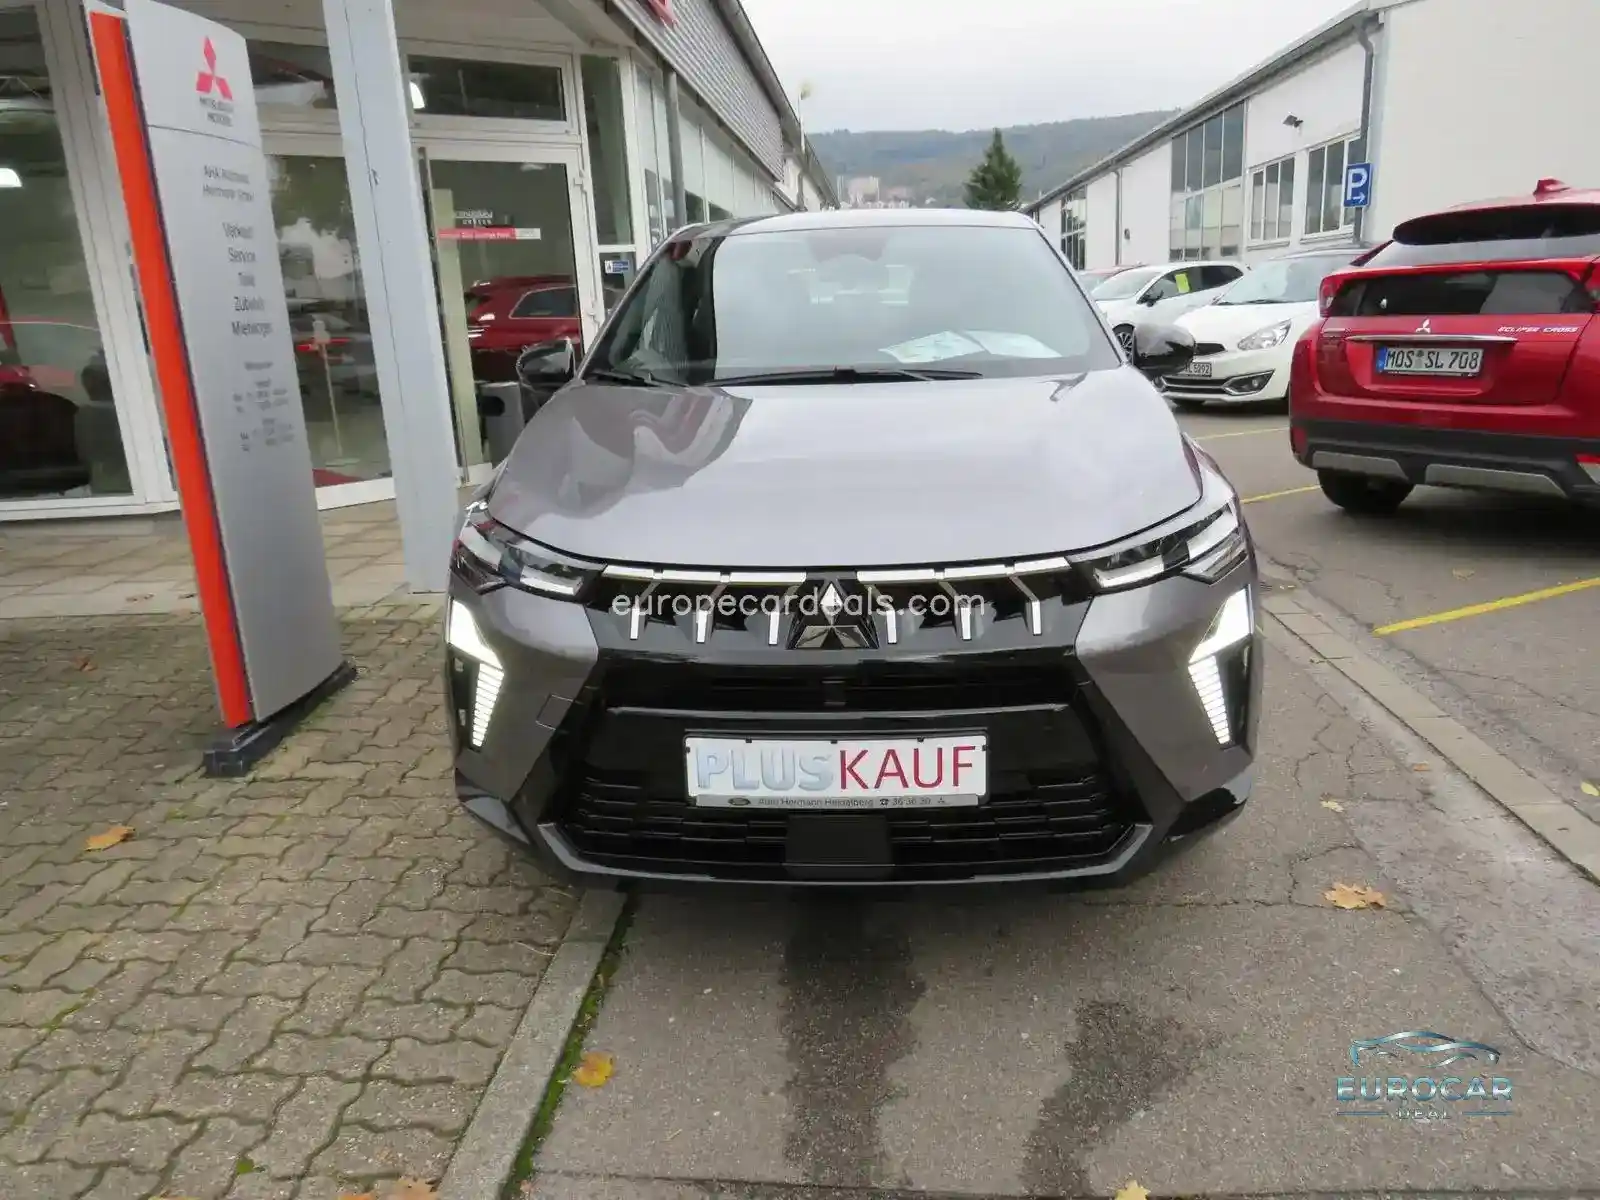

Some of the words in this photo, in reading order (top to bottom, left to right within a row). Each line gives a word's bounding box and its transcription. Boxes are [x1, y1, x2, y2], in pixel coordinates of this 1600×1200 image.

[1347, 168, 1368, 200] P
[222, 222, 253, 239] Verk
[1386, 350, 1414, 368] MOS
[1424, 350, 1444, 368] SL
[1448, 351, 1479, 369] 708
[696, 746, 834, 791] PLUS
[839, 745, 976, 790] KAUF
